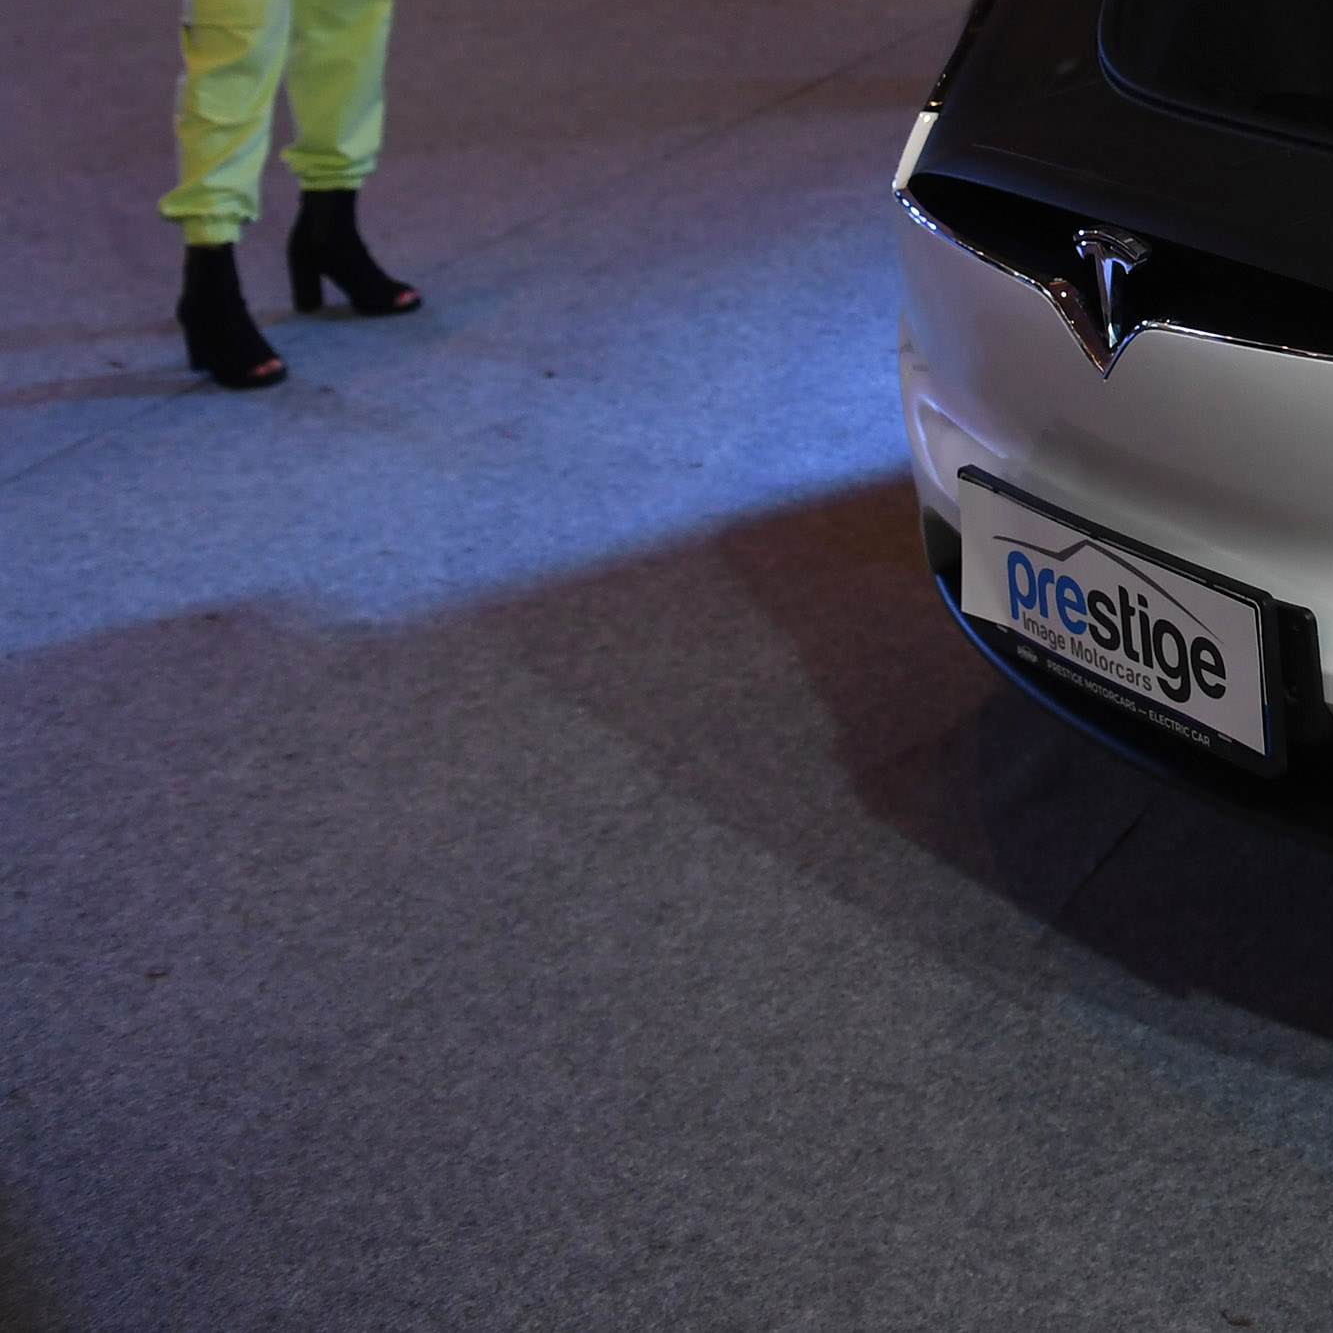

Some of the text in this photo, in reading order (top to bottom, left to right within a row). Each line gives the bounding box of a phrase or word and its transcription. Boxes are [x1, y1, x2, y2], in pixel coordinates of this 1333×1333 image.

[1007, 550, 1227, 704] prestige
[1023, 611, 1153, 692] Image Motorcars
[1149, 709, 1190, 738] ELECTRIC
[1191, 728, 1211, 747] CAR
